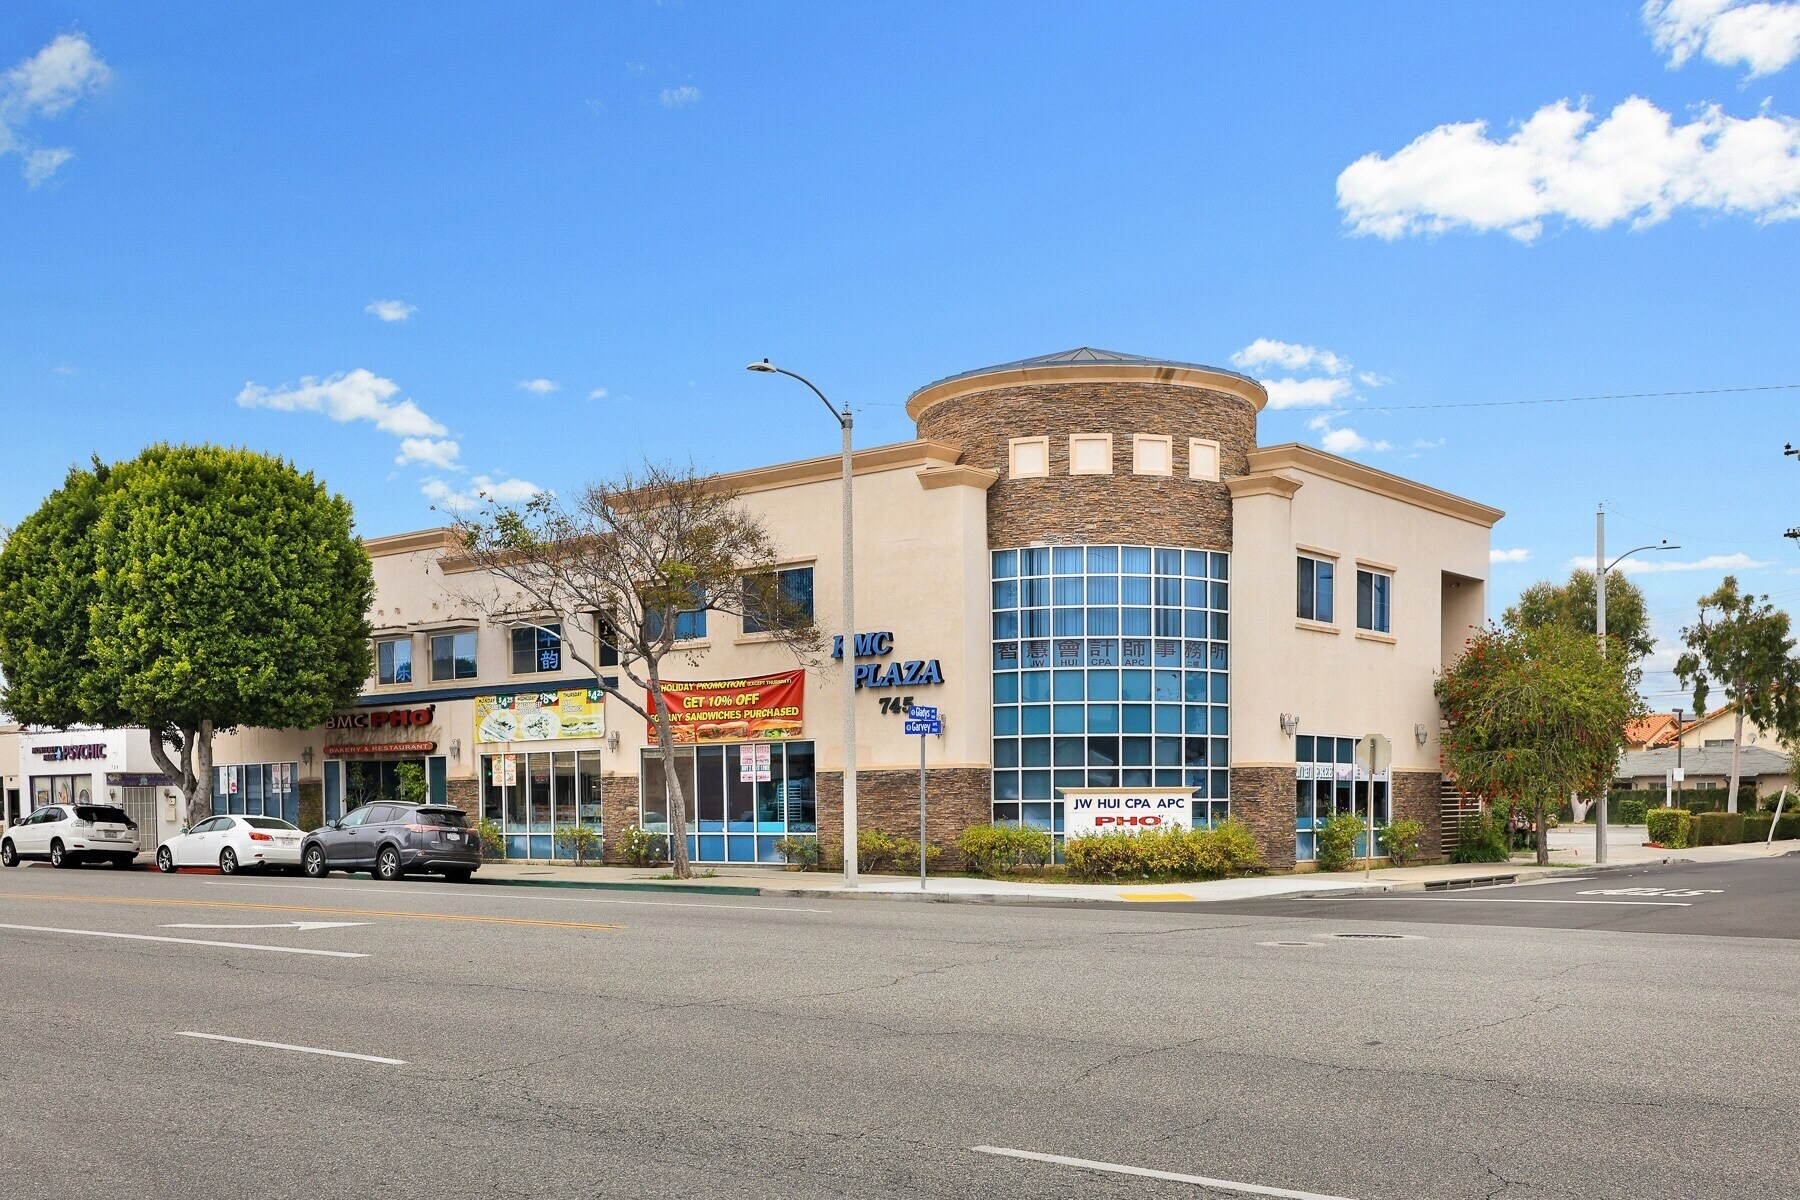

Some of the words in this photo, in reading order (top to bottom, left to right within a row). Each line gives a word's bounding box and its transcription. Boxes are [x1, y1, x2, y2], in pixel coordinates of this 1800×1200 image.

[999, 639, 1225, 660] 智慧會計師事務所
[1030, 660, 1044, 668] JW
[1091, 658, 1112, 666] CPA
[1124, 659, 1145, 667] APC
[855, 659, 944, 688] PLAZA
[661, 683, 694, 692] HOLIDAY
[696, 680, 746, 690] PROMOTION
[683, 696, 705, 709] GET
[709, 695, 732, 708] 10%
[736, 693, 759, 706] OFF
[879, 696, 914, 714] 745
[326, 714, 366, 729] BMC
[685, 711, 741, 722] SANDWICHES
[744, 707, 799, 719] PURCHASED
[912, 722, 930, 733] Garvey
[62, 743, 107, 760] PSYCHIC
[372, 743, 428, 752] RESTAURANT
[1074, 799, 1092, 810] JW
[1098, 799, 1120, 809] HUI
[1125, 799, 1151, 809] CPA
[1157, 799, 1184, 809] APC
